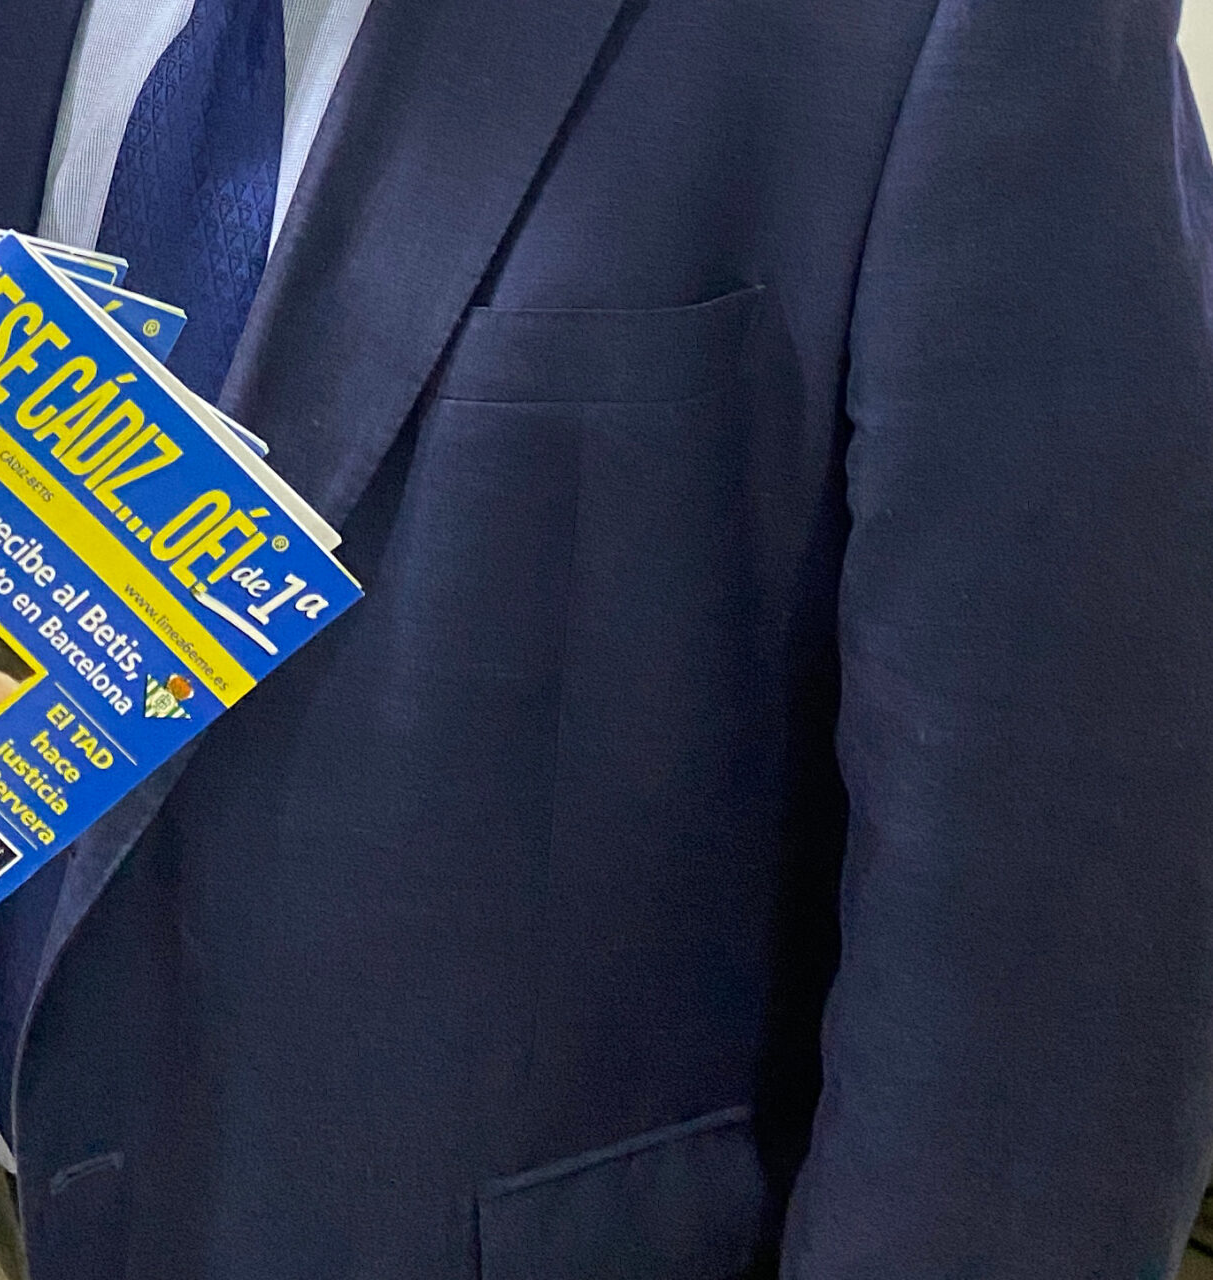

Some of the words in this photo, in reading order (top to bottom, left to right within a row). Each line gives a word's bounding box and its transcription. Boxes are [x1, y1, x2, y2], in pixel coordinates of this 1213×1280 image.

[230, 566, 272, 598] de
[11, 592, 43, 624] en
[37, 615, 134, 716] Barcelona
[51, 582, 90, 613] al
[77, 603, 144, 682] Betis,
[29, 729, 81, 784] hace
[45, 702, 76, 732] El
[68, 723, 115, 770] TAD
